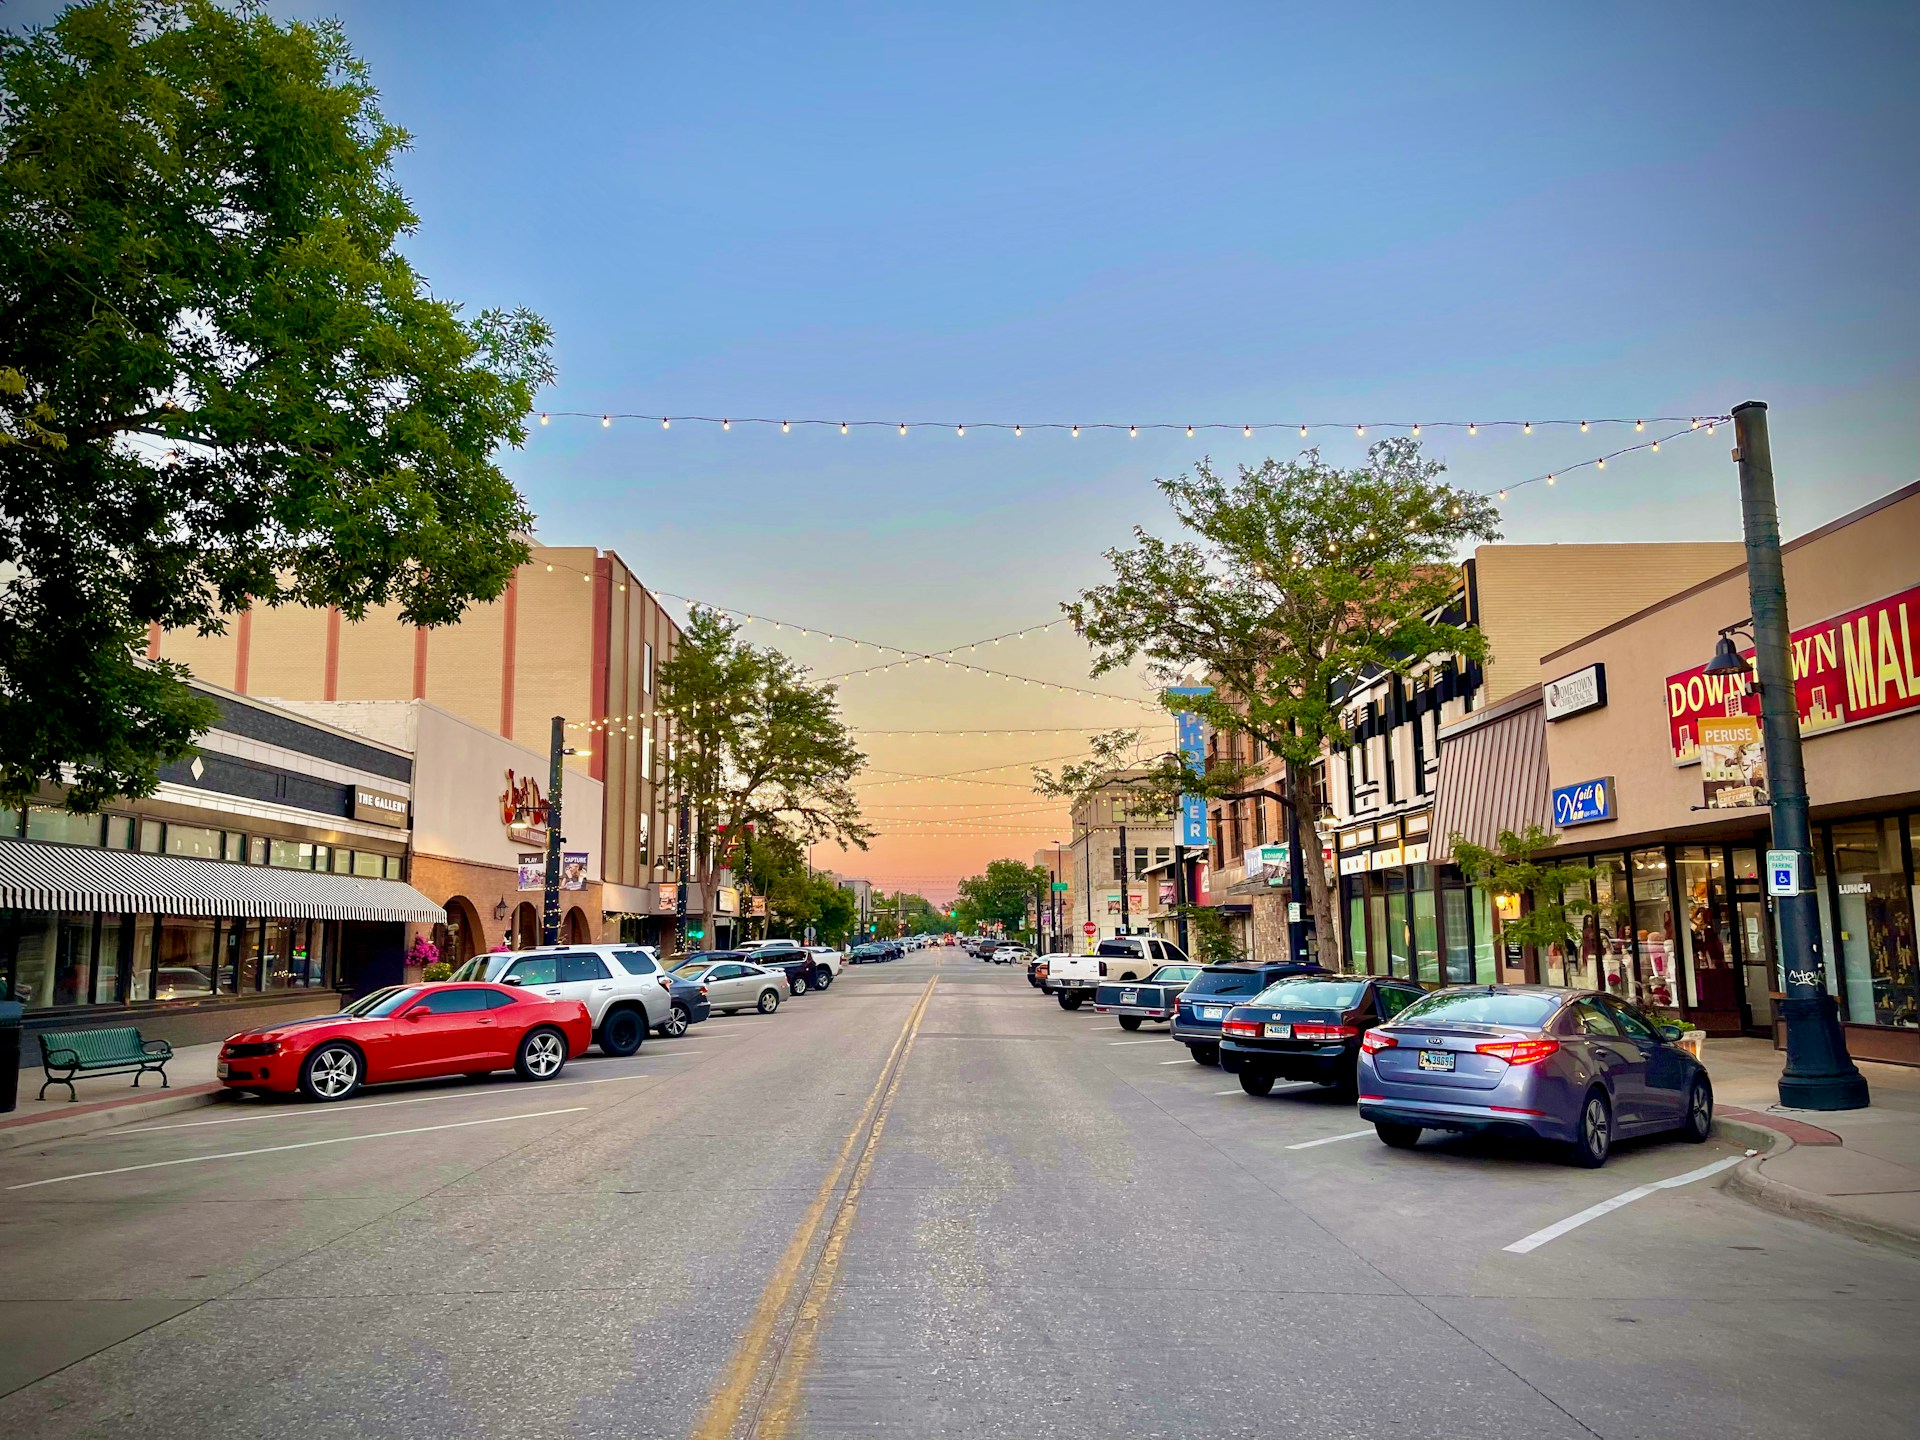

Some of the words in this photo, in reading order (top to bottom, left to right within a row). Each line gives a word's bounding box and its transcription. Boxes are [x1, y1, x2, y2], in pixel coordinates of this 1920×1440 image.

[1705, 728, 1753, 742] PERUSE
[1186, 714, 1201, 838] PIOER
[358, 792, 374, 806] THE
[375, 796, 406, 813] GALLERY
[1838, 883, 1872, 894] LUNCH
[1084, 924, 1097, 932] STOP
